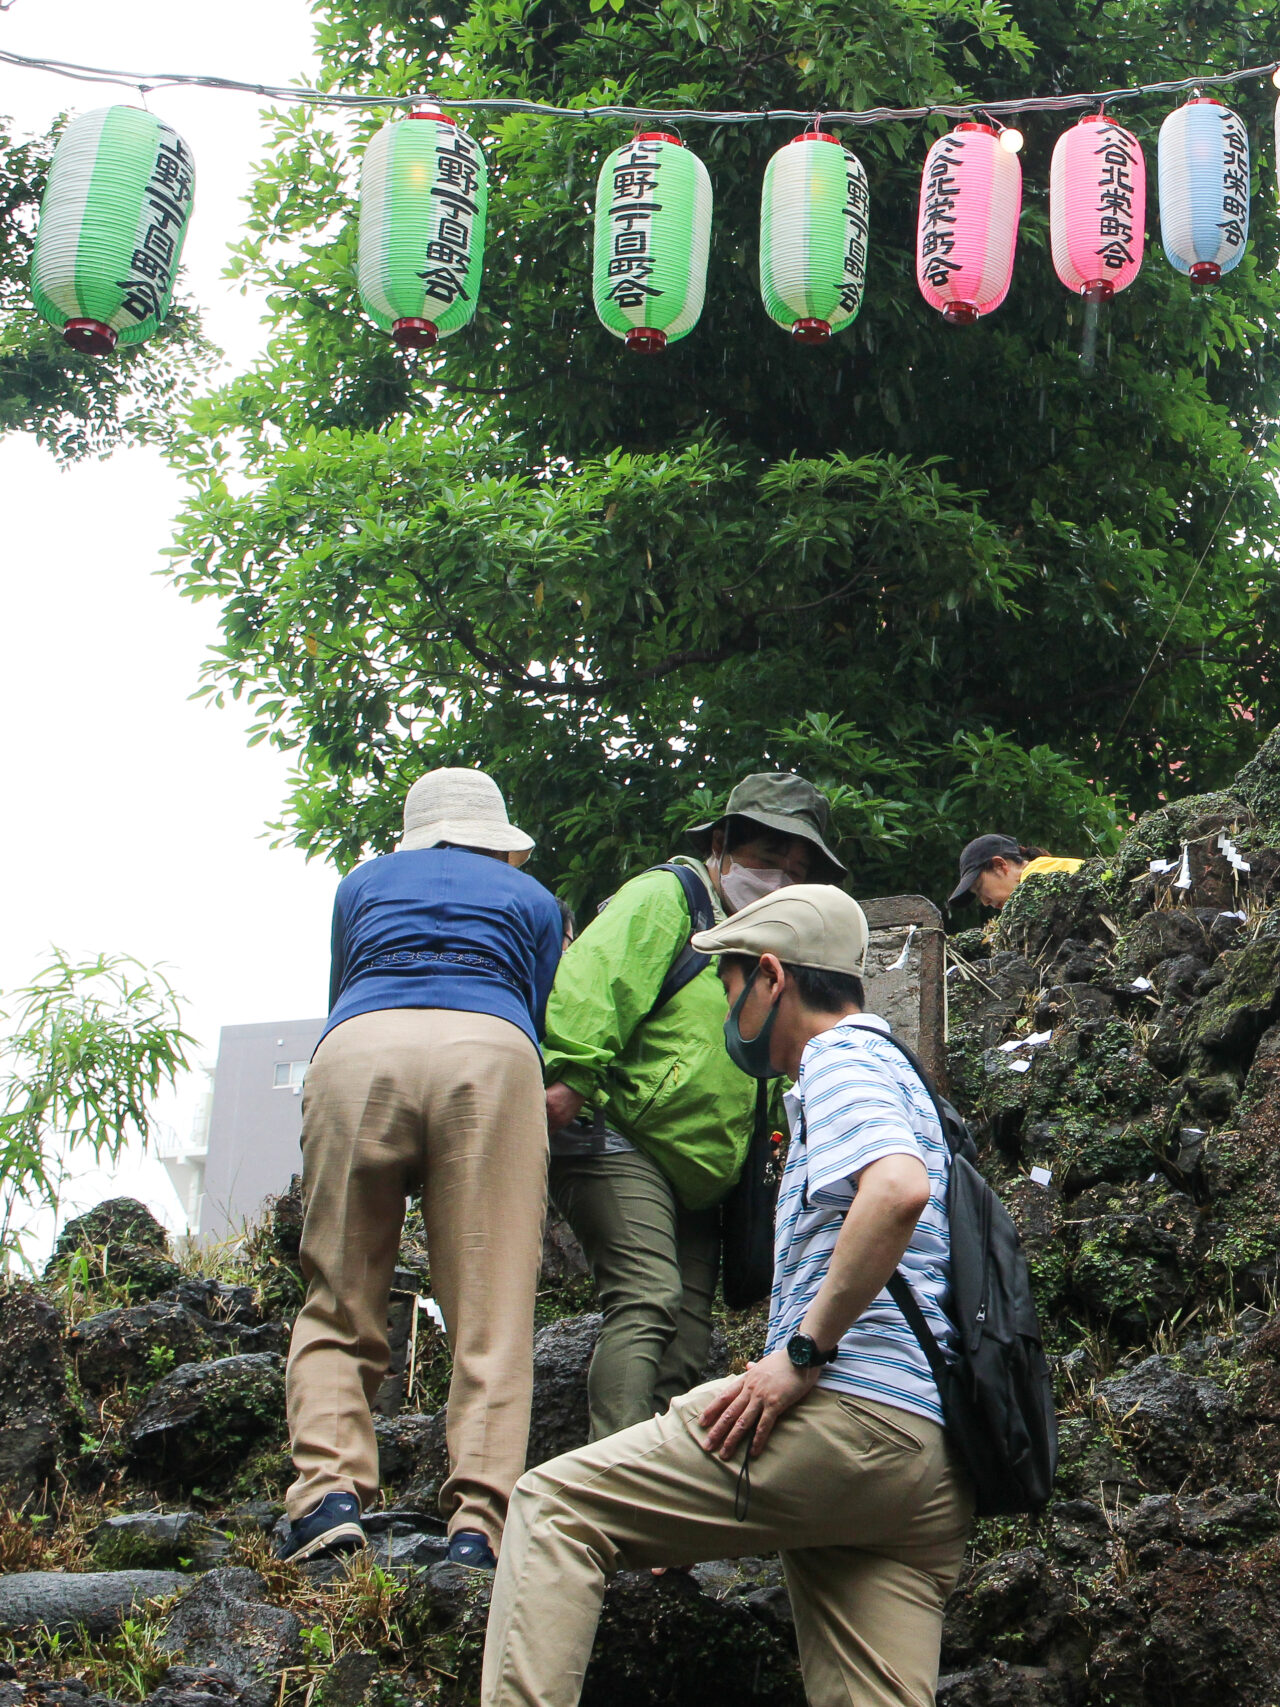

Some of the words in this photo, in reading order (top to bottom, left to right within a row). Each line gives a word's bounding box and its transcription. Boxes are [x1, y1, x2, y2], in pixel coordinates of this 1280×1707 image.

[115, 124, 195, 322] 上野一丁目町会
[605, 142, 665, 308] 北上野一丁目町会
[922, 137, 965, 287] 入谷北栄町会
[1094, 123, 1138, 269] 入谷北栄町会
[1214, 108, 1249, 247] 入谷北栄町会
